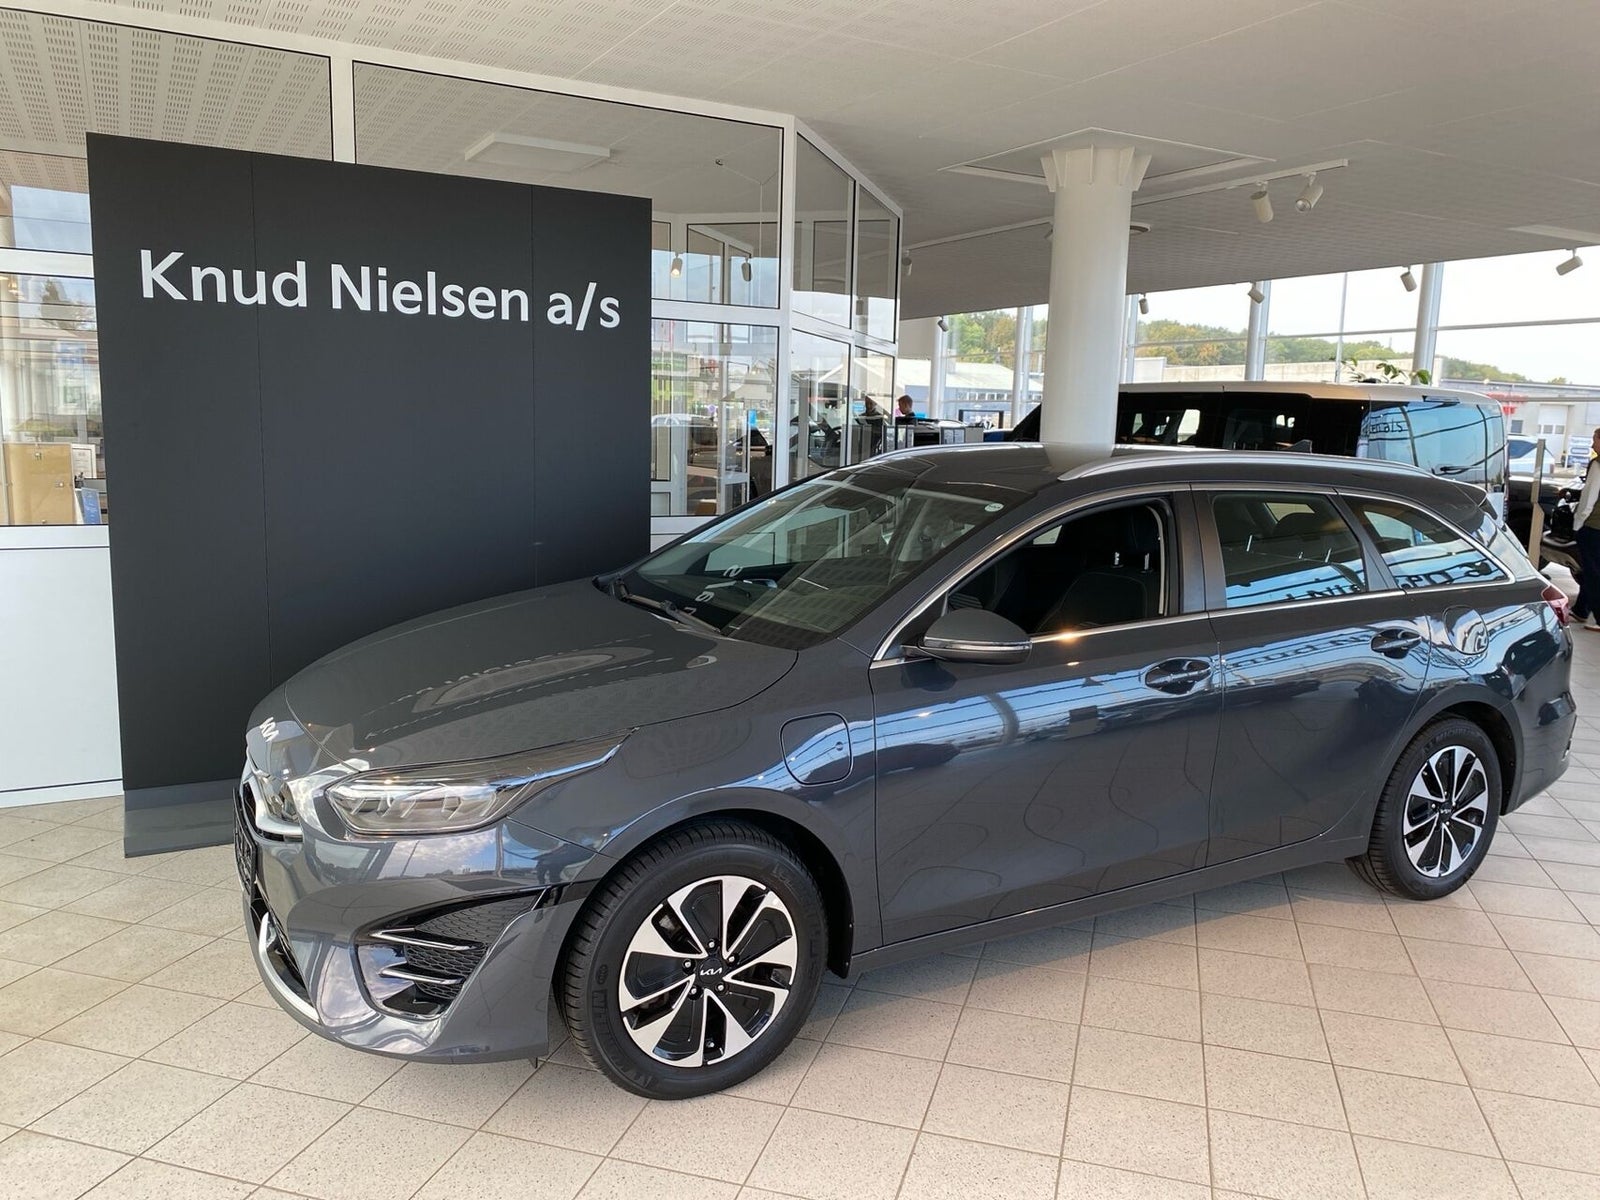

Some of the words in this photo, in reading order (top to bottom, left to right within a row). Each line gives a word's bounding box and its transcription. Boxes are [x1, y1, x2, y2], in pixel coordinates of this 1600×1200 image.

[139, 248, 308, 308] Knud
[330, 263, 530, 322] Nielsen
[546, 281, 622, 331] a/s
